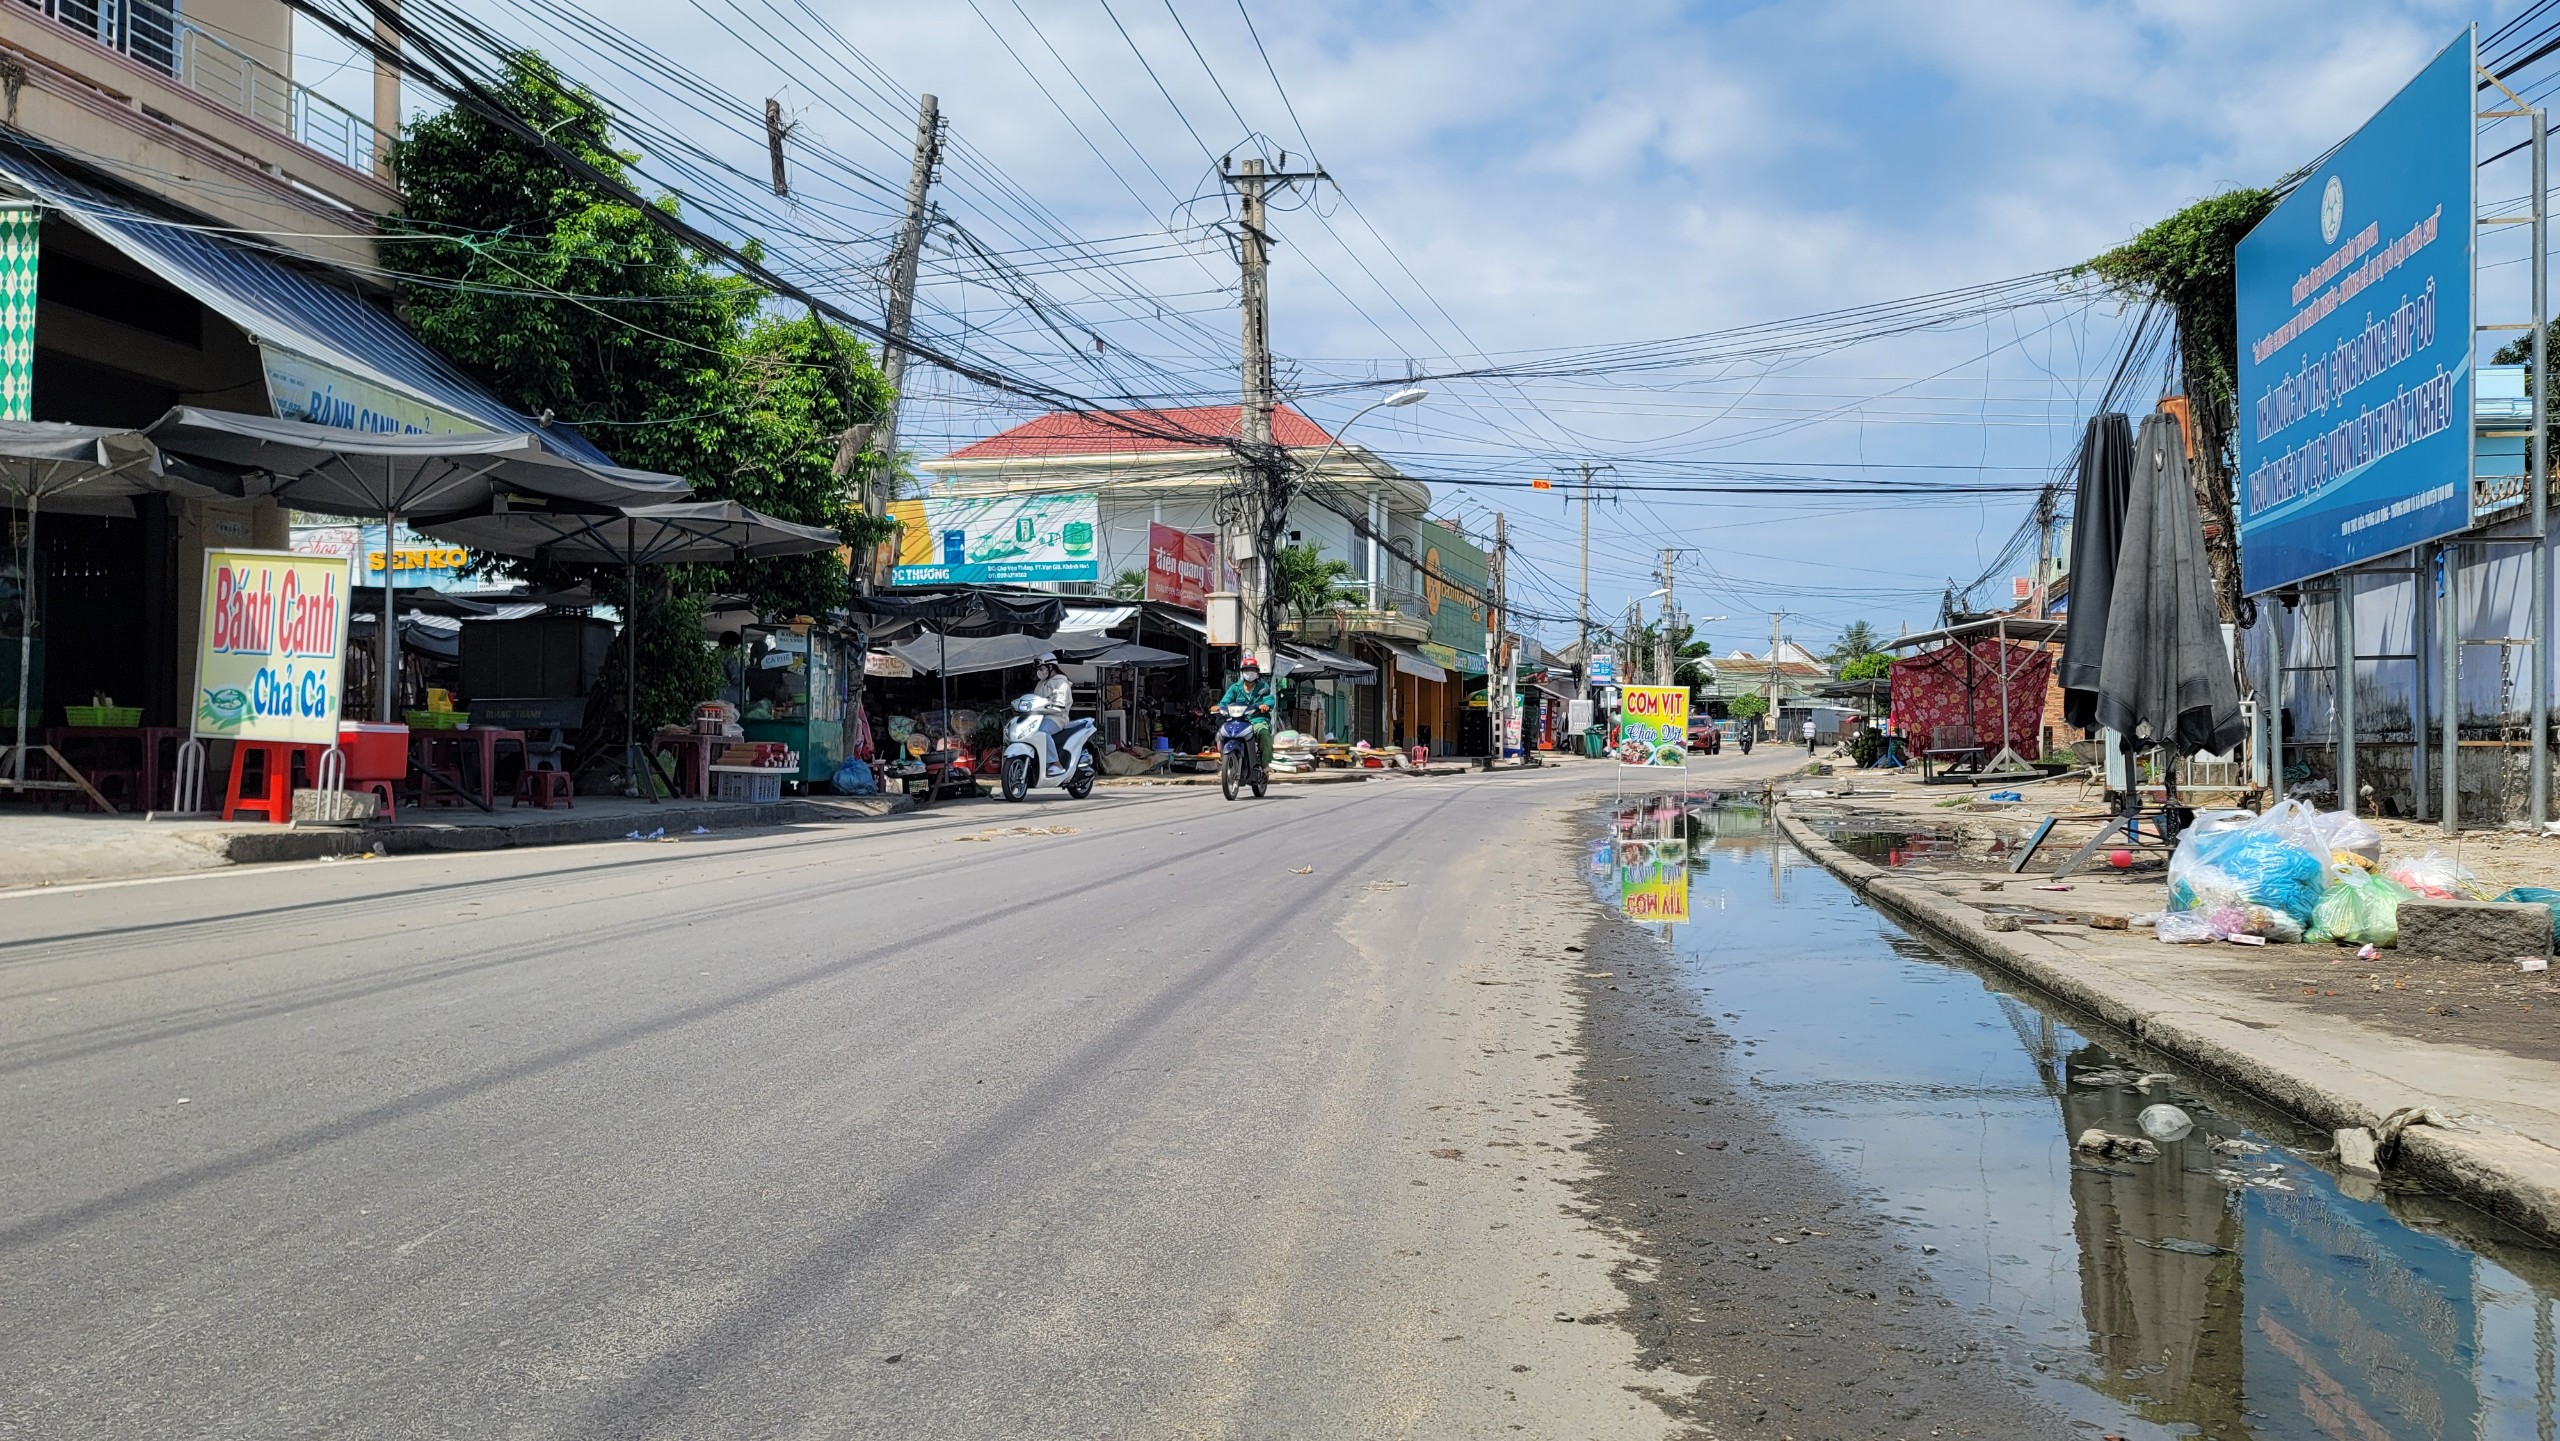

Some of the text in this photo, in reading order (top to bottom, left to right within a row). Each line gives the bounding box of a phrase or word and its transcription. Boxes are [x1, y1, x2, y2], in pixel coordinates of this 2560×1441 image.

[2257, 385, 2273, 443] NHÀ
[2274, 373, 2295, 433] NƯỚC
[2330, 338, 2356, 407] CỘNG
[2358, 312, 2386, 384] ĐỒNG
[2389, 295, 2415, 367] GIÚP
[2417, 276, 2434, 351] ĐỠ
[310, 385, 355, 431] BÁNH
[2249, 364, 2453, 516] NGƯỜI NGHÈO TỰ LỰC VƯƠN LÊN THOÁT NGHÈO
[368, 549, 467, 571] SENKO
[905, 567, 950, 580] THƯƠNG
[1153, 546, 1177, 576] điện
[1178, 559, 1205, 589] quang
[212, 567, 338, 658] Bánh Canh
[254, 663, 326, 718] Chả Cá
[1661, 692, 1683, 721] VỊT
[1625, 722, 1657, 741] Cháo
